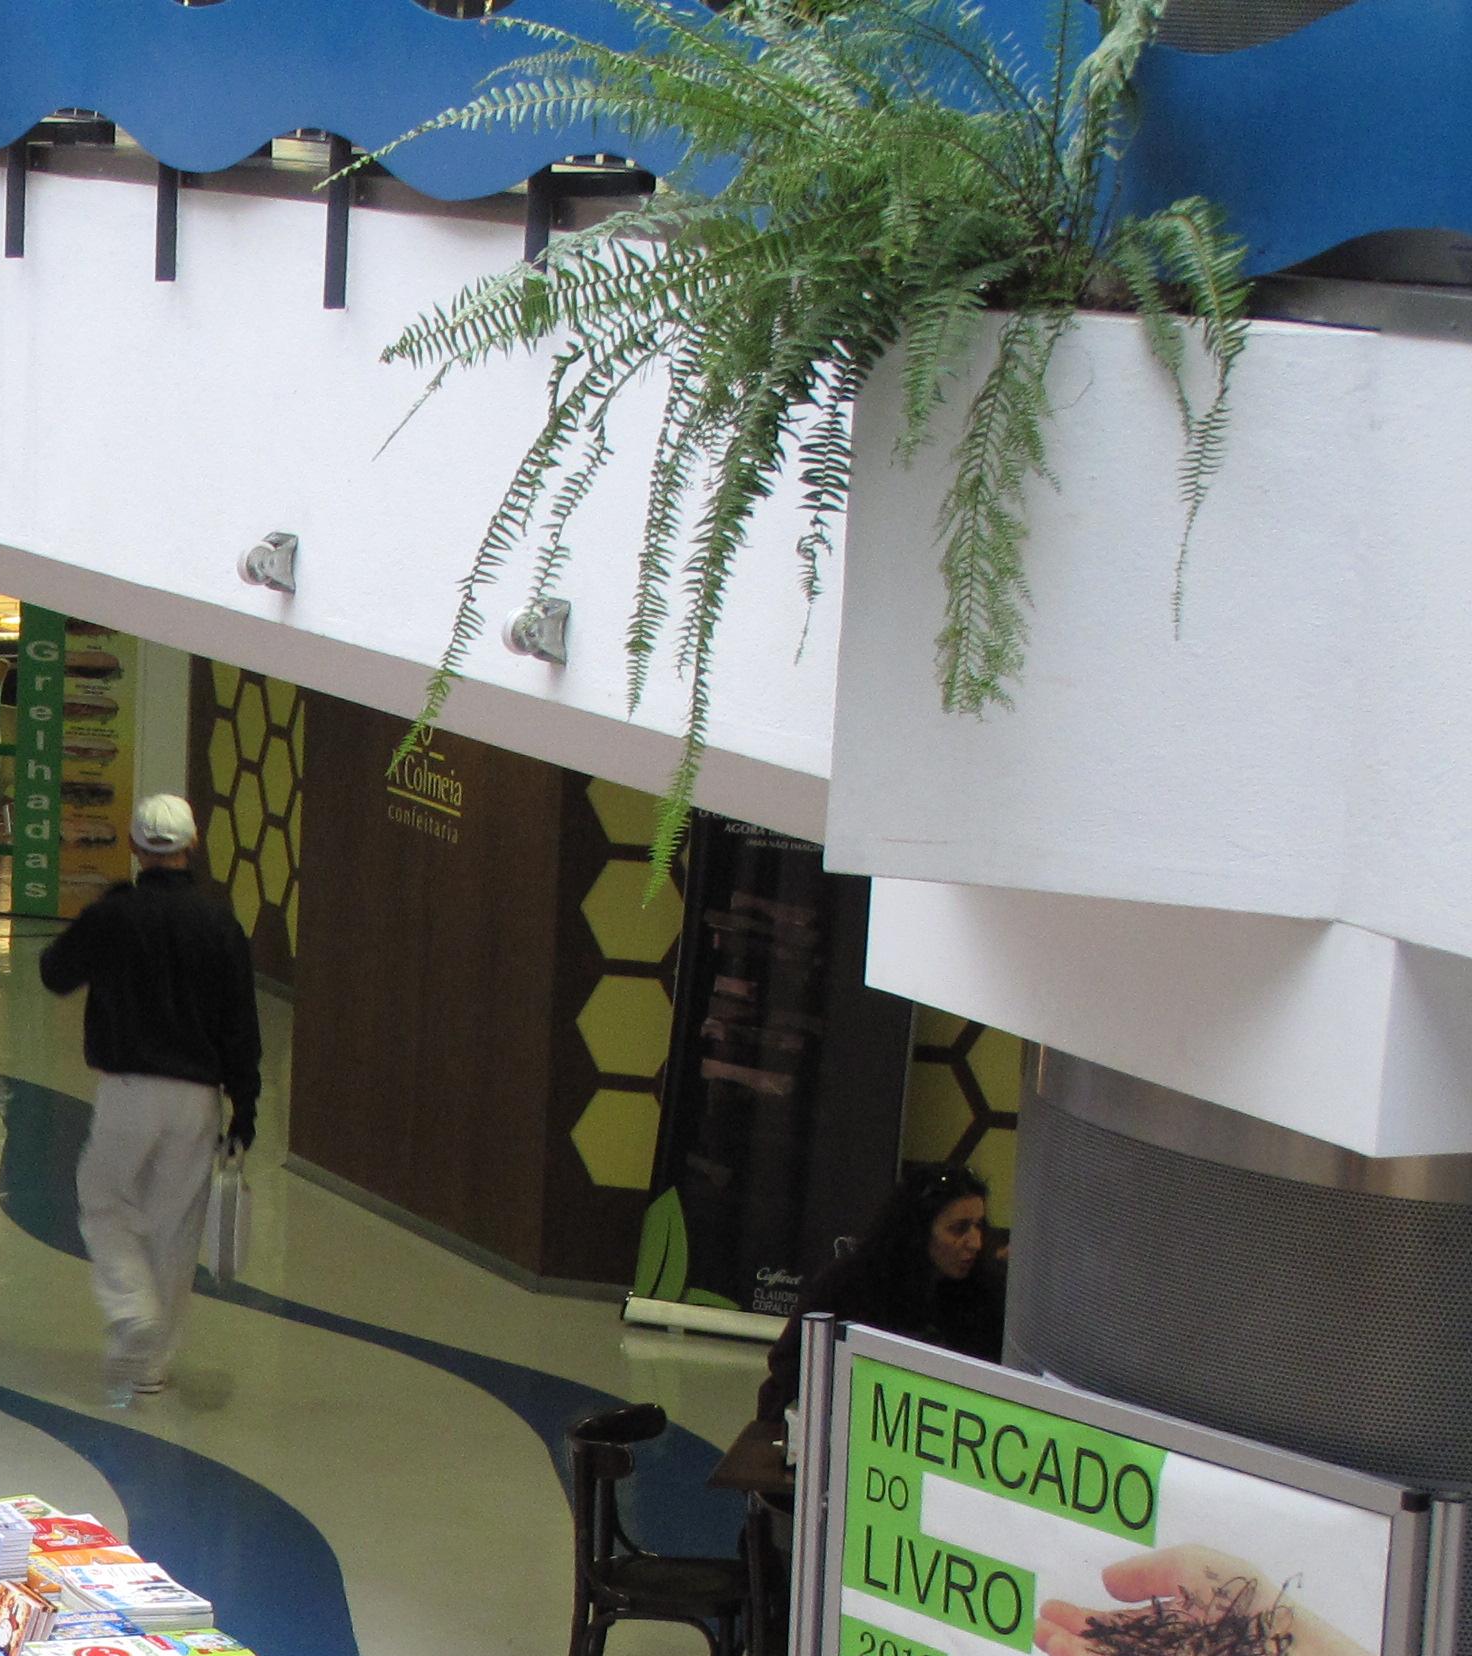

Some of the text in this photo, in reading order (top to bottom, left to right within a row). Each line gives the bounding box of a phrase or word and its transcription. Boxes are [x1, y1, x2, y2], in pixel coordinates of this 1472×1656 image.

[25, 640, 59, 898] Grelhadas
[405, 755, 462, 806] Colmeia
[388, 804, 458, 843] confeitaria
[867, 1466, 909, 1511] DO
[871, 1382, 1154, 1531] MERCADO
[864, 1525, 1022, 1635] LIVRO
